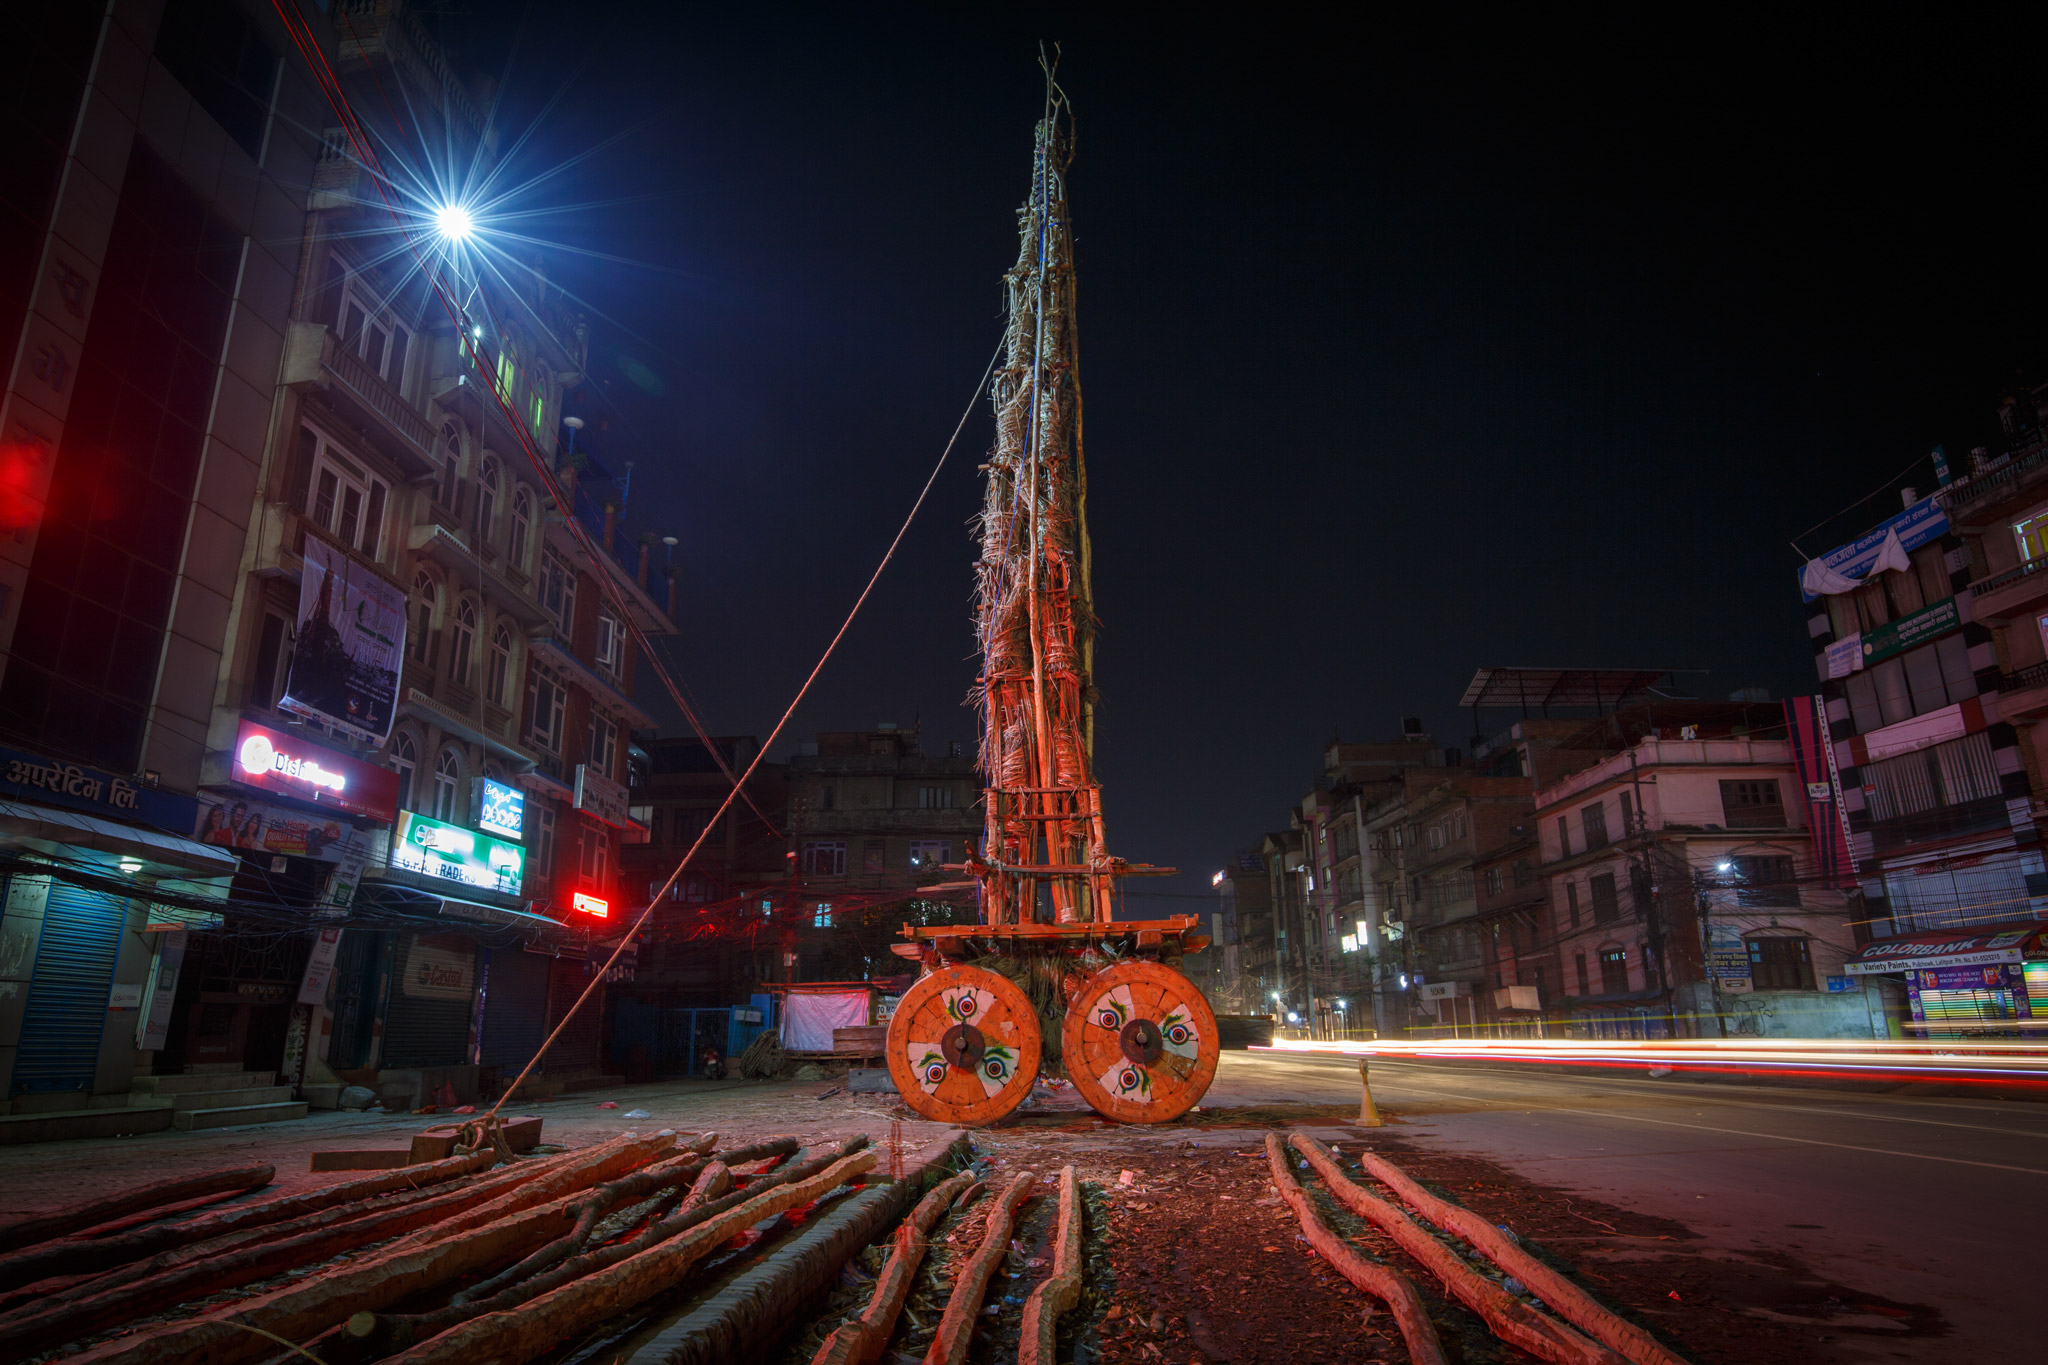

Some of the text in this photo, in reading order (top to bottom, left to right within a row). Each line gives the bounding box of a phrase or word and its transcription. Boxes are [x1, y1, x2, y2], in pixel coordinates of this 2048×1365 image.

[108, 777, 139, 809] लि.
[1862, 938, 1979, 957] COLORBANK
[1863, 963, 1887, 972] Variety
[1888, 961, 1912, 970] Paints,
